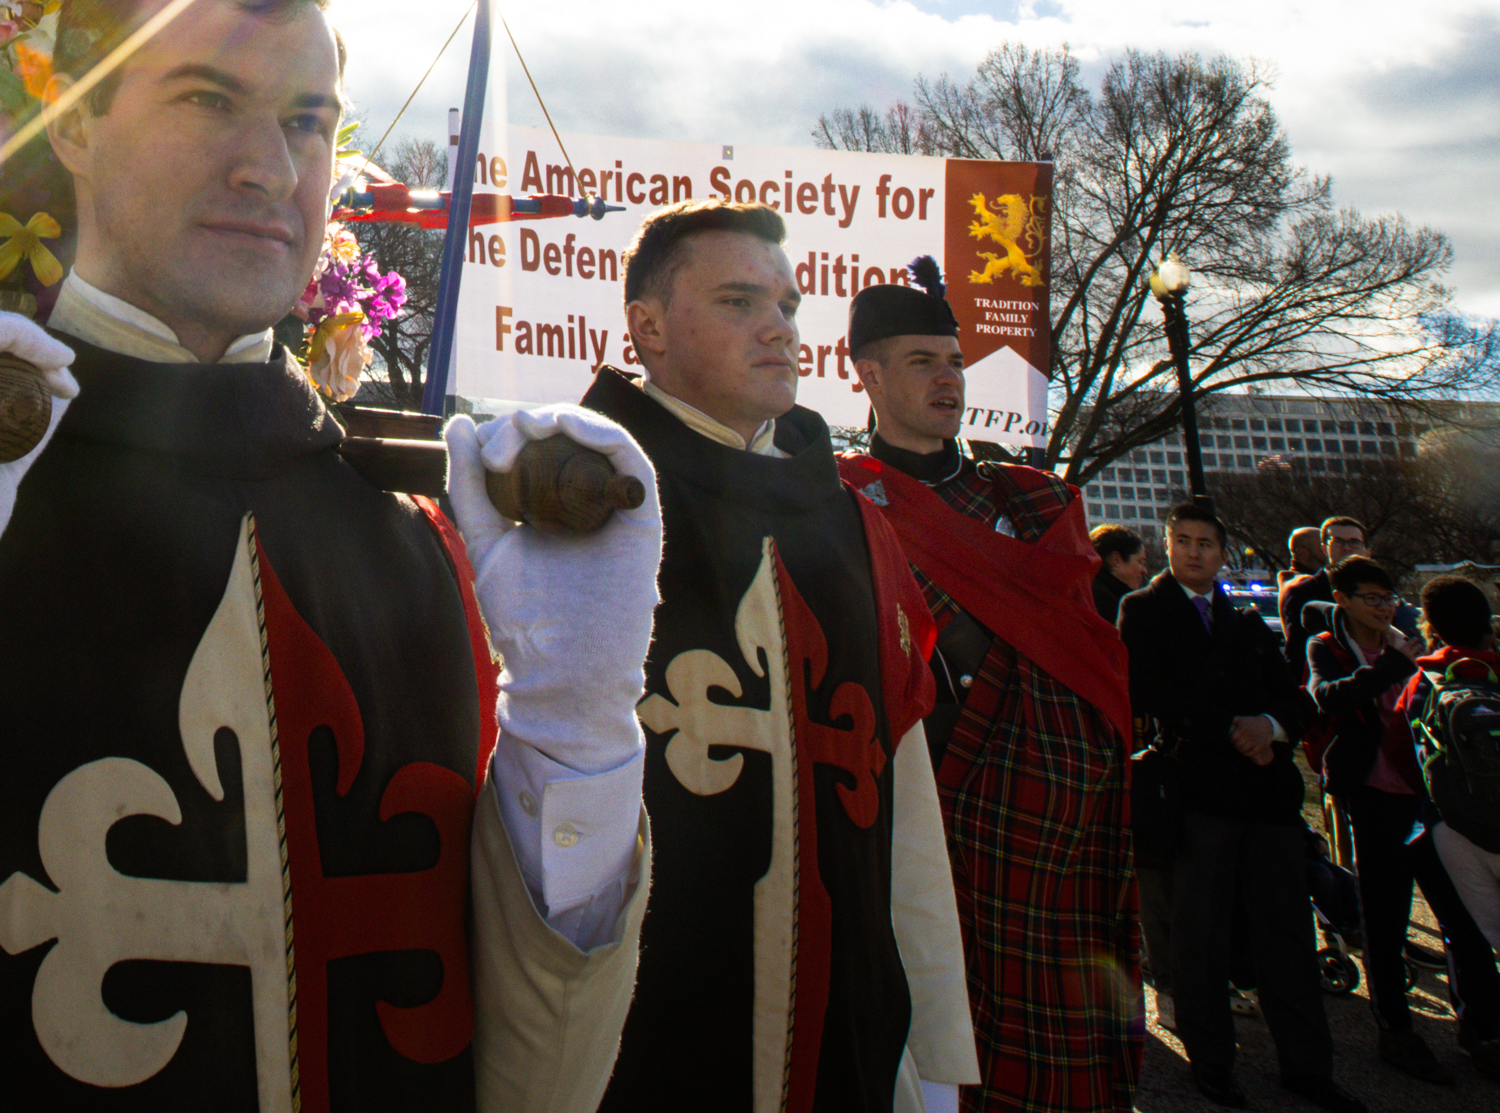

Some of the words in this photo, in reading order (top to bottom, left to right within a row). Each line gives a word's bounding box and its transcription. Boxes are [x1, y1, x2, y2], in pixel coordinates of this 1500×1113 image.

[521, 150, 693, 205] American
[709, 166, 861, 229] Society
[876, 174, 935, 220] for
[463, 226, 506, 268] he
[974, 298, 1039, 311] TRADITION
[985, 311, 1029, 323] FAMILY
[495, 305, 608, 373] Family
[975, 323, 1037, 337] PROPERTY
